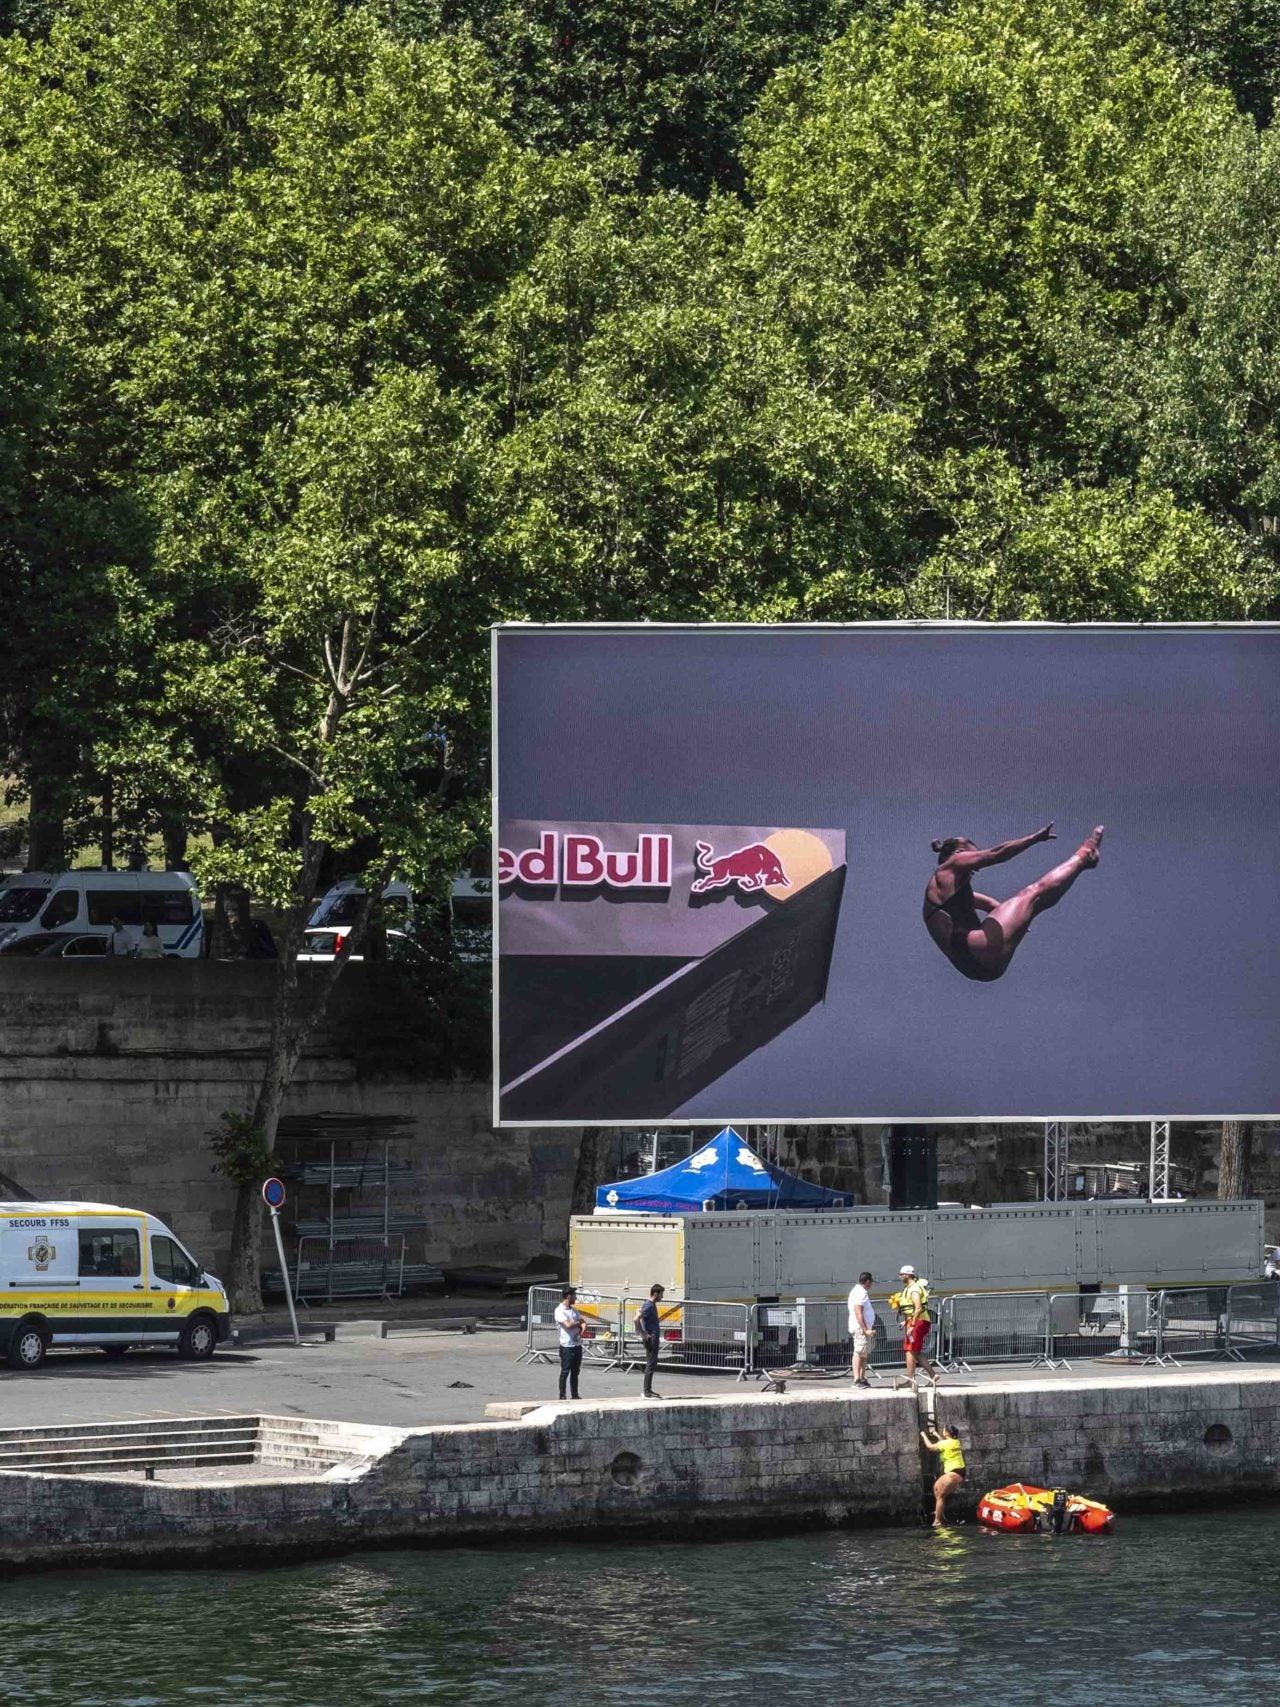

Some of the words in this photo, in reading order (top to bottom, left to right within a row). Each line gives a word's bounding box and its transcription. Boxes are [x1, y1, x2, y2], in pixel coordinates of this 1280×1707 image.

[565, 835, 671, 885] Bull
[8, 1219, 47, 1228] SECOURS
[50, 1218, 70, 1227] FFSS
